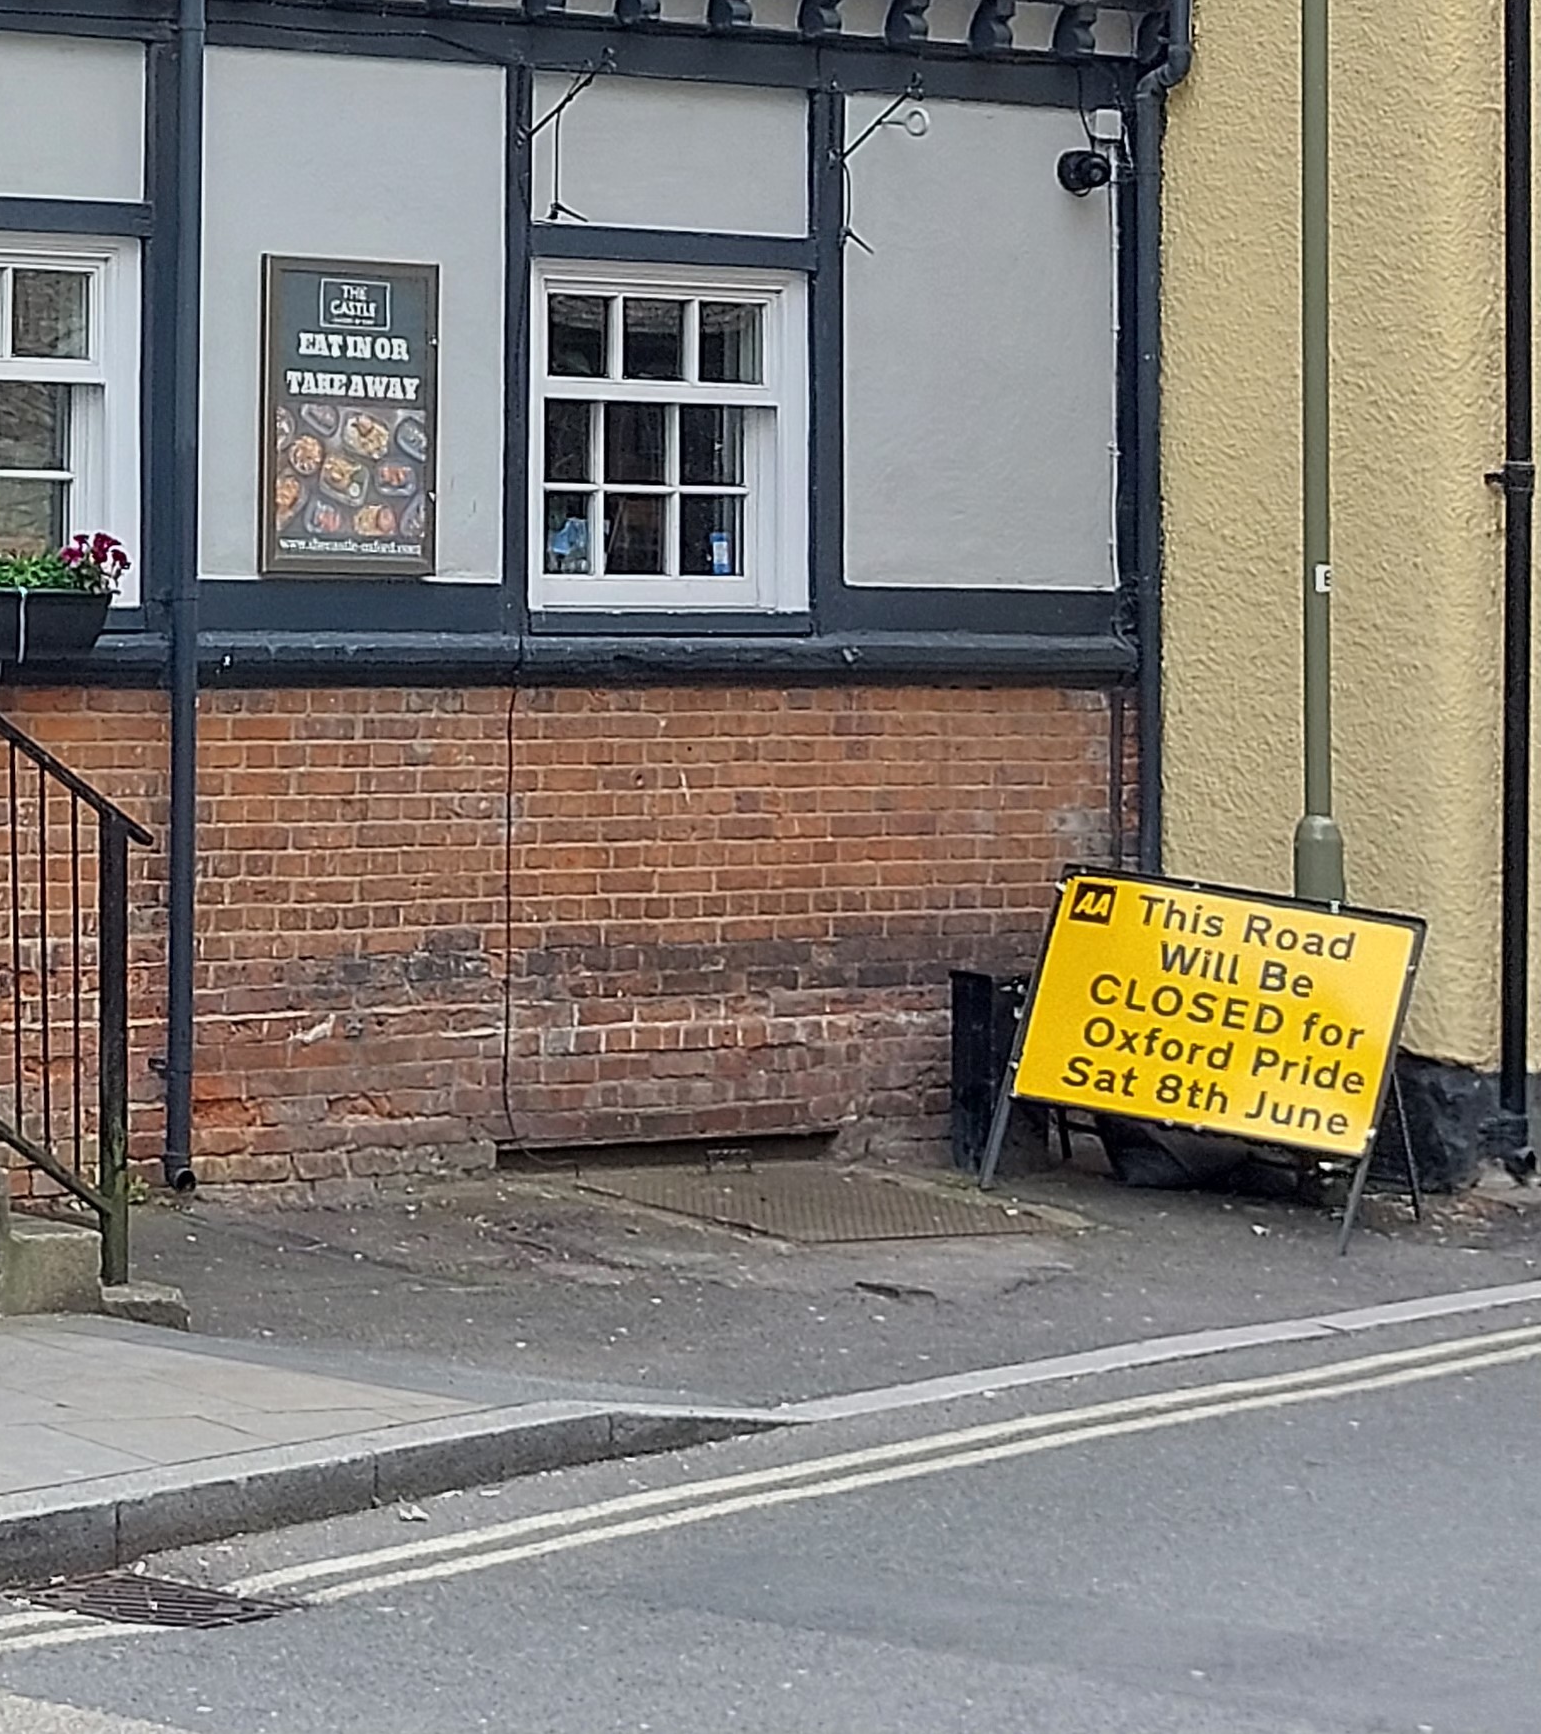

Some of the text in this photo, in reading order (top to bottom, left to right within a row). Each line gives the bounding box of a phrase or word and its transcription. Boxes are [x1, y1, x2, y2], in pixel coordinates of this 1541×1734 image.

[330, 300, 376, 317] CASTLE
[341, 285, 368, 300] THE
[299, 332, 409, 361] EAT IN OR
[1074, 891, 1356, 962] AA This Road
[1160, 940, 1314, 998] Will Be
[1090, 973, 1365, 1051] CLOSED for
[1083, 1017, 1365, 1095] Oxford Pride
[1062, 1056, 1349, 1135] Sat 8th June
